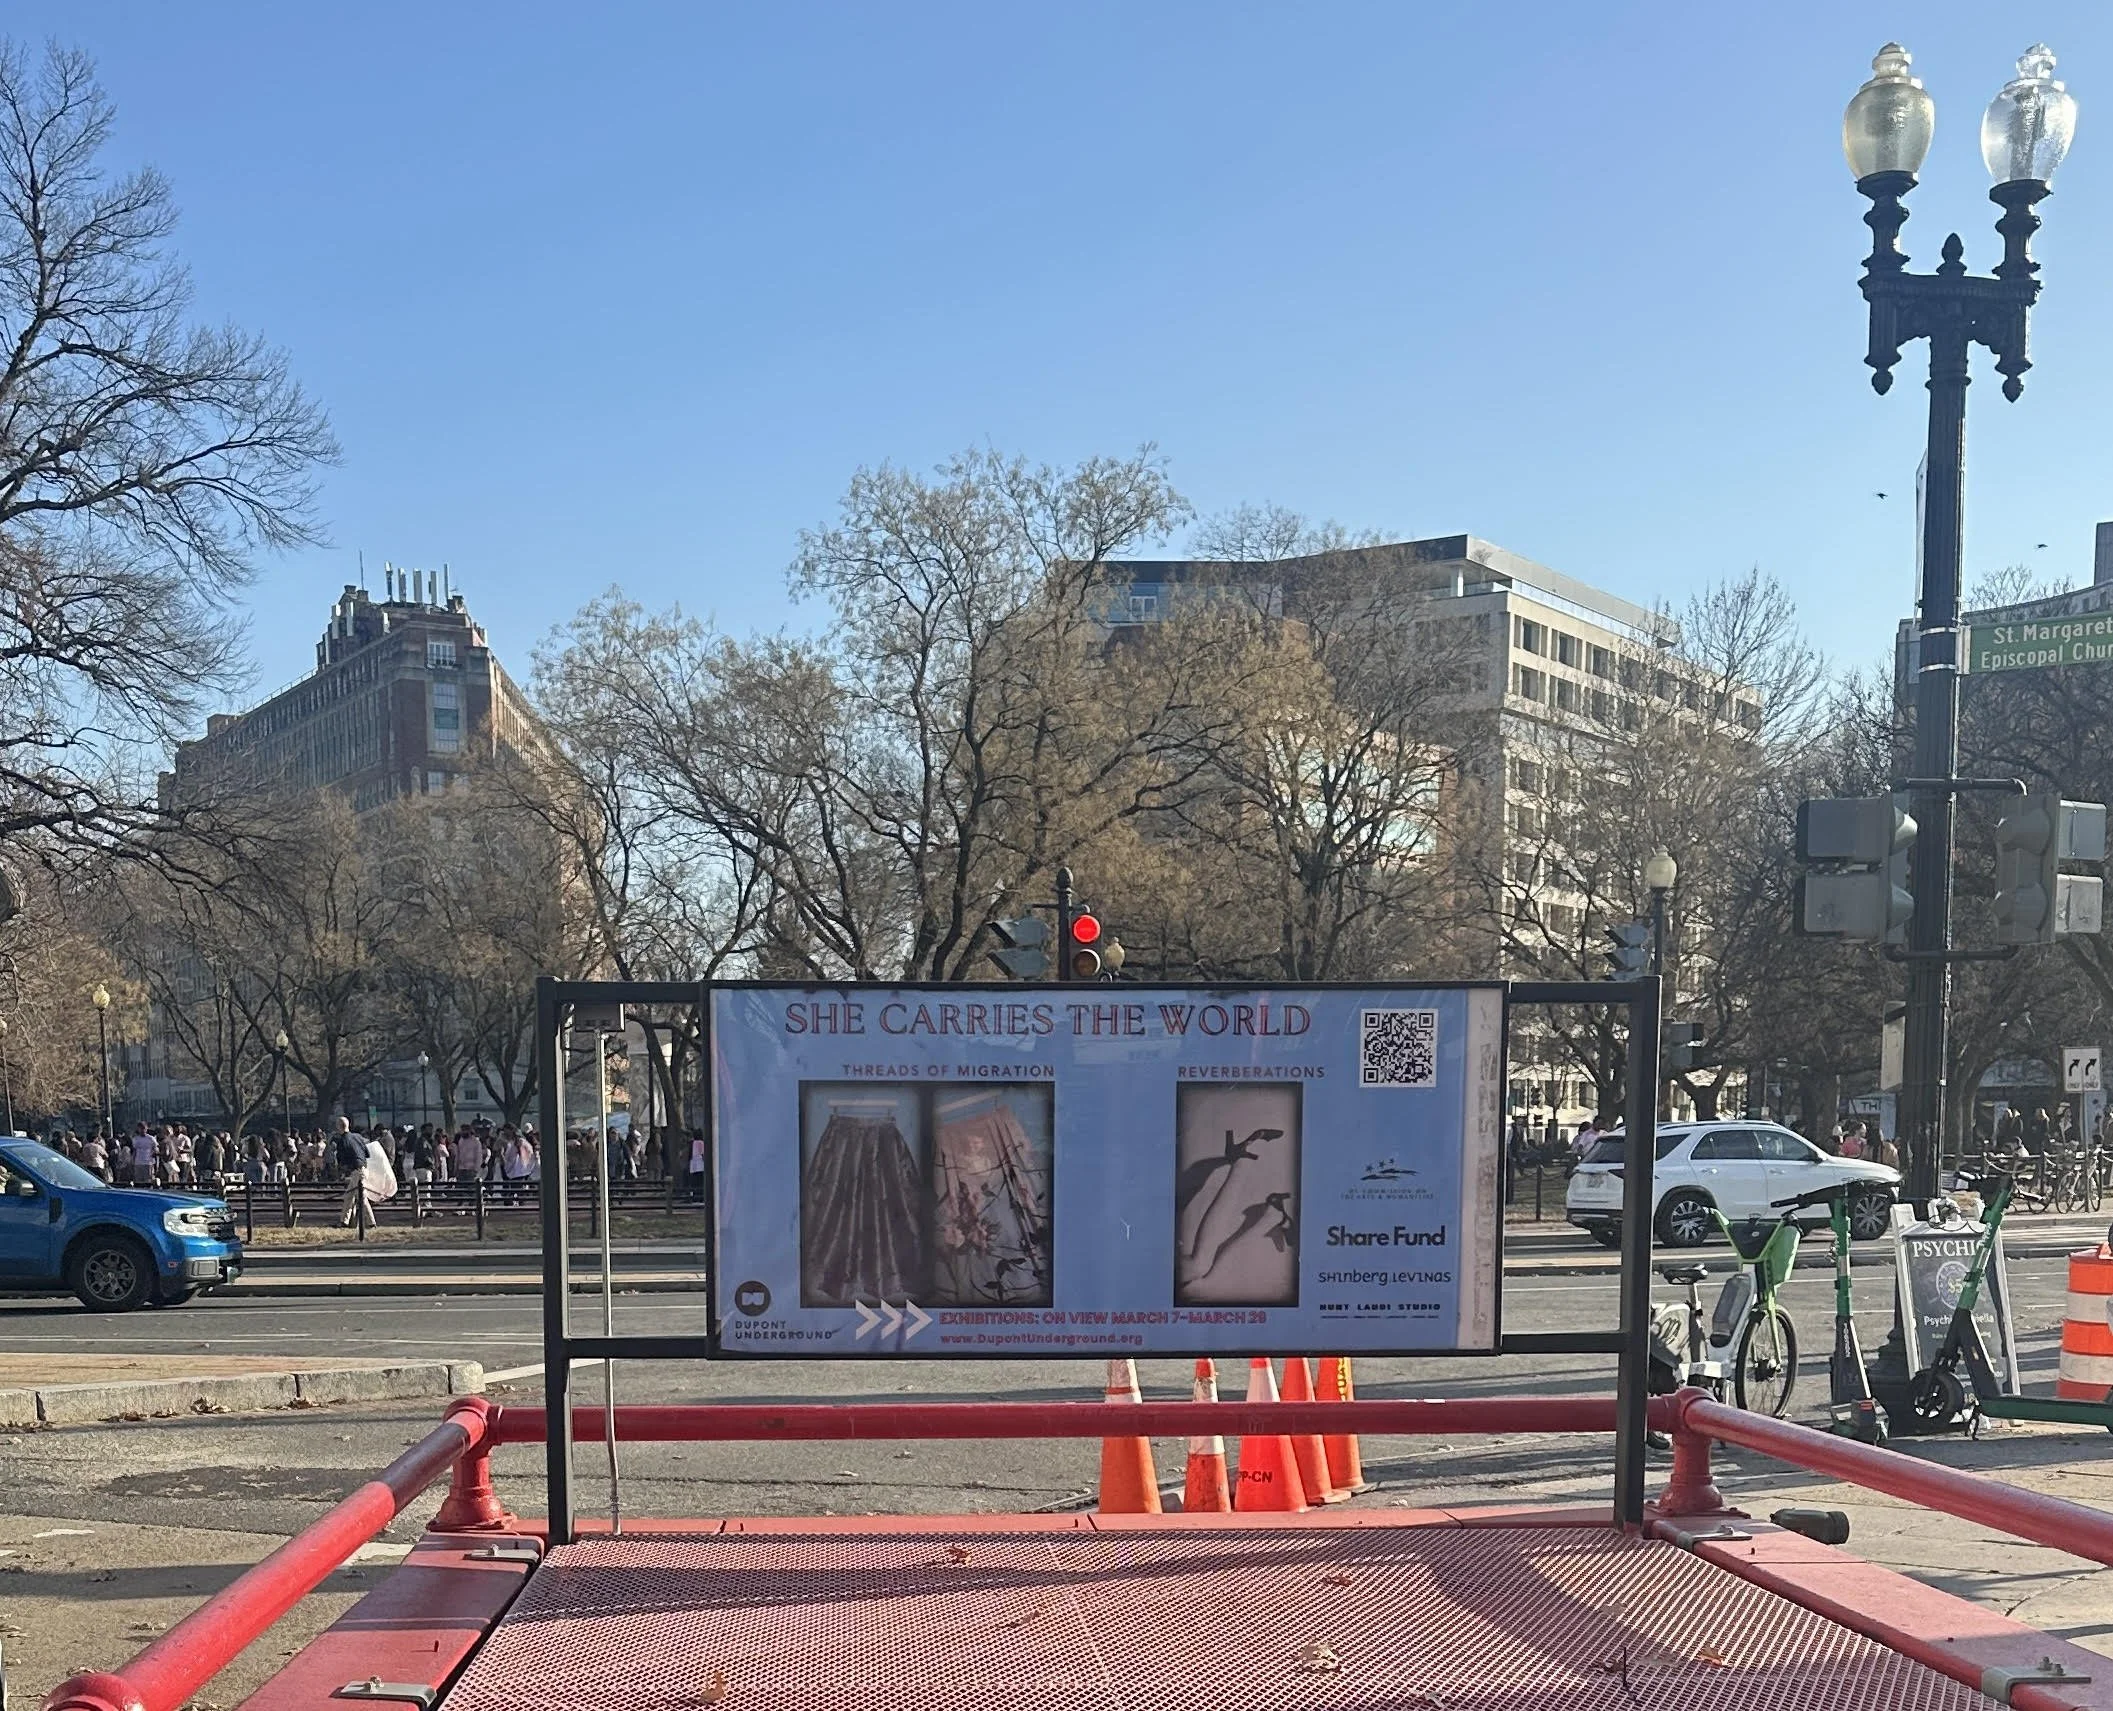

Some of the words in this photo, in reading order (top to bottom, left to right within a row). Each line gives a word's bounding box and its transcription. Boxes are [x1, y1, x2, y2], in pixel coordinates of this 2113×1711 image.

[1993, 626, 2019, 644] St.
[1981, 645, 2063, 671] Episcopal
[785, 1003, 865, 1034] SHE
[879, 1003, 1055, 1035] CARRIES
[1066, 1004, 1145, 1035] THE
[1158, 1004, 1311, 1036] WORLD
[842, 1064, 920, 1077] THREADS
[927, 1065, 948, 1076] OF
[957, 1064, 1055, 1077] MIGRATION
[1178, 1066, 1325, 1078] REVERBERATIONS
[1326, 1225, 1390, 1247] Share
[1393, 1225, 1446, 1247] Fund
[1398, 1303, 1441, 1311] STUDIO
[735, 1320, 786, 1329] DUPONT
[939, 1311, 1040, 1325] EXHIBITIONS:
[1042, 1312, 1066, 1324] ON
[1071, 1312, 1108, 1324] VIEW
[1111, 1311, 1168, 1324] MARCH
[1924, 1313, 1953, 1328] Psychi
[735, 1331, 833, 1340] UNDERGROUND
[940, 1333, 1143, 1347] www.DupontUnderground.org
